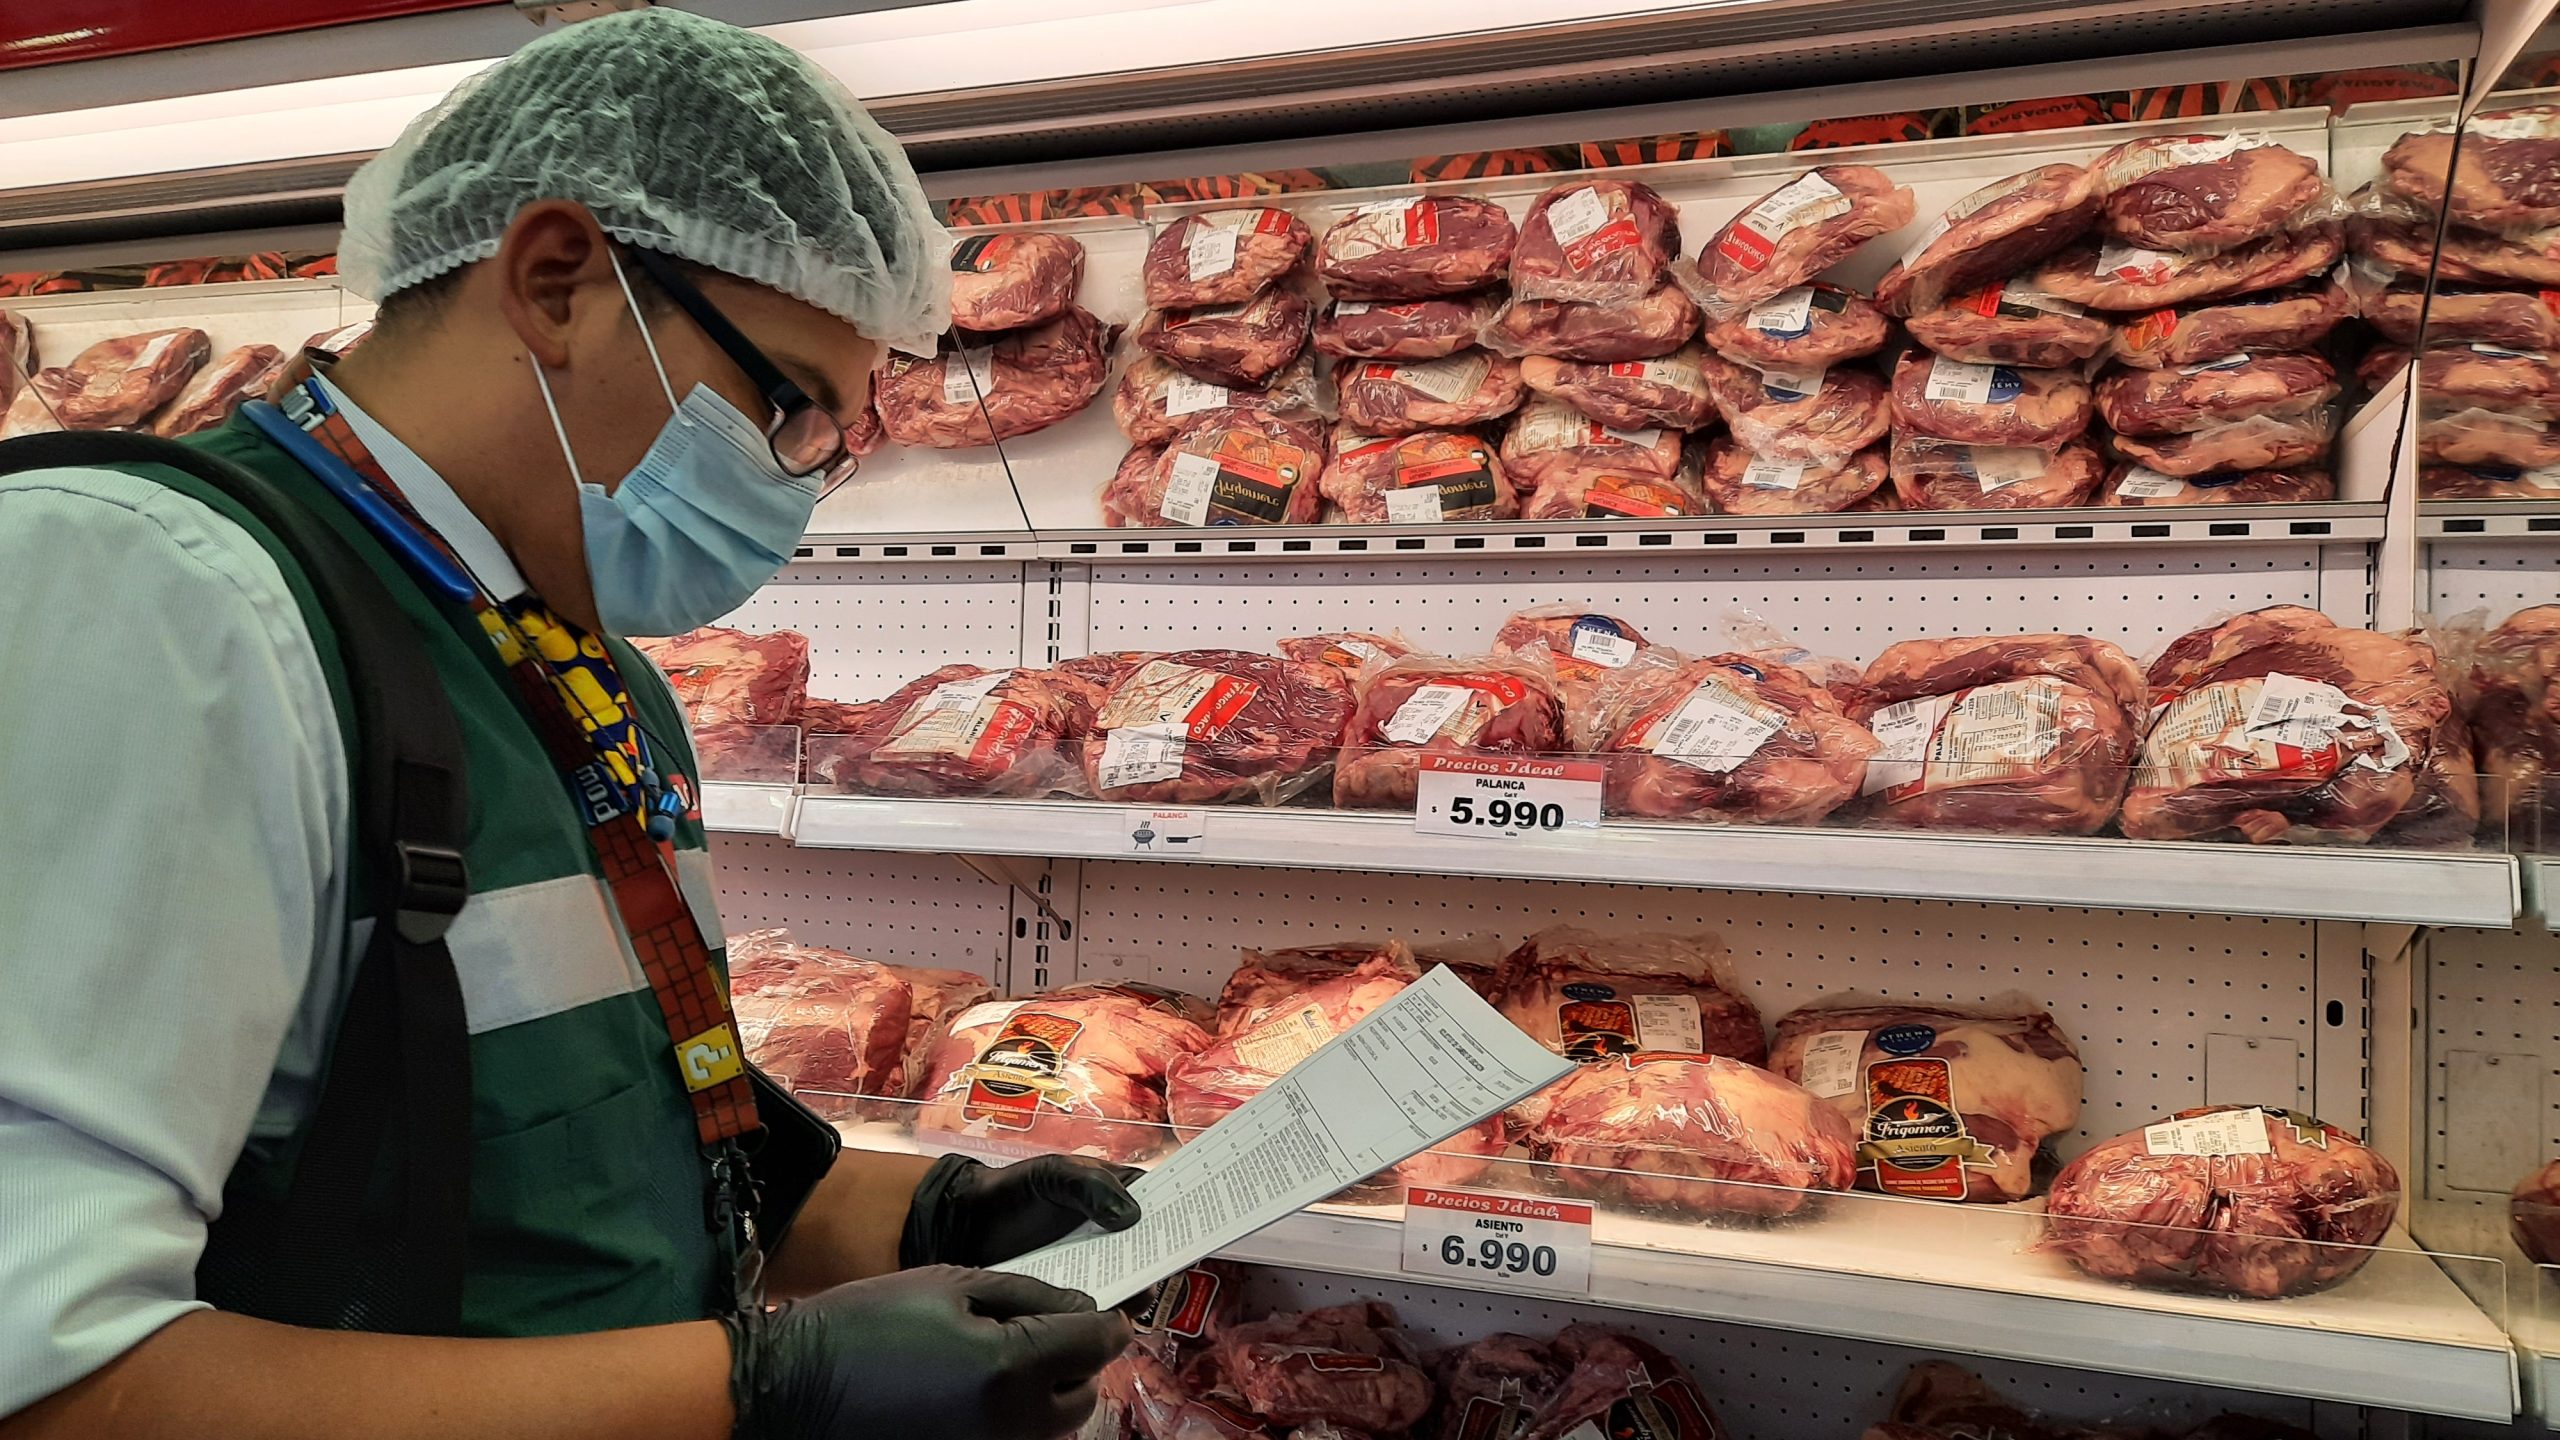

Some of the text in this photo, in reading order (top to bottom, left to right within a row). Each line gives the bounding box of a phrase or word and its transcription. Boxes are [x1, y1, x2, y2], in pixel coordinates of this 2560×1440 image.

[1182, 686, 1205, 709] PALANCA
[1433, 757, 1565, 777] Precios Ideal
[576, 764, 622, 824] POW
[1475, 778, 1526, 791] PALANCA
[1152, 812, 1188, 820] PALANCA
[1449, 797, 1564, 832] 5.990
[1879, 1029, 1933, 1042] ATHENA
[1877, 1121, 1951, 1139] Frigomerc
[1424, 1192, 1560, 1219] Precios Ideal
[1475, 1218, 1524, 1233] ASIENTO
[1422, 1235, 1556, 1276] $ 6.990
